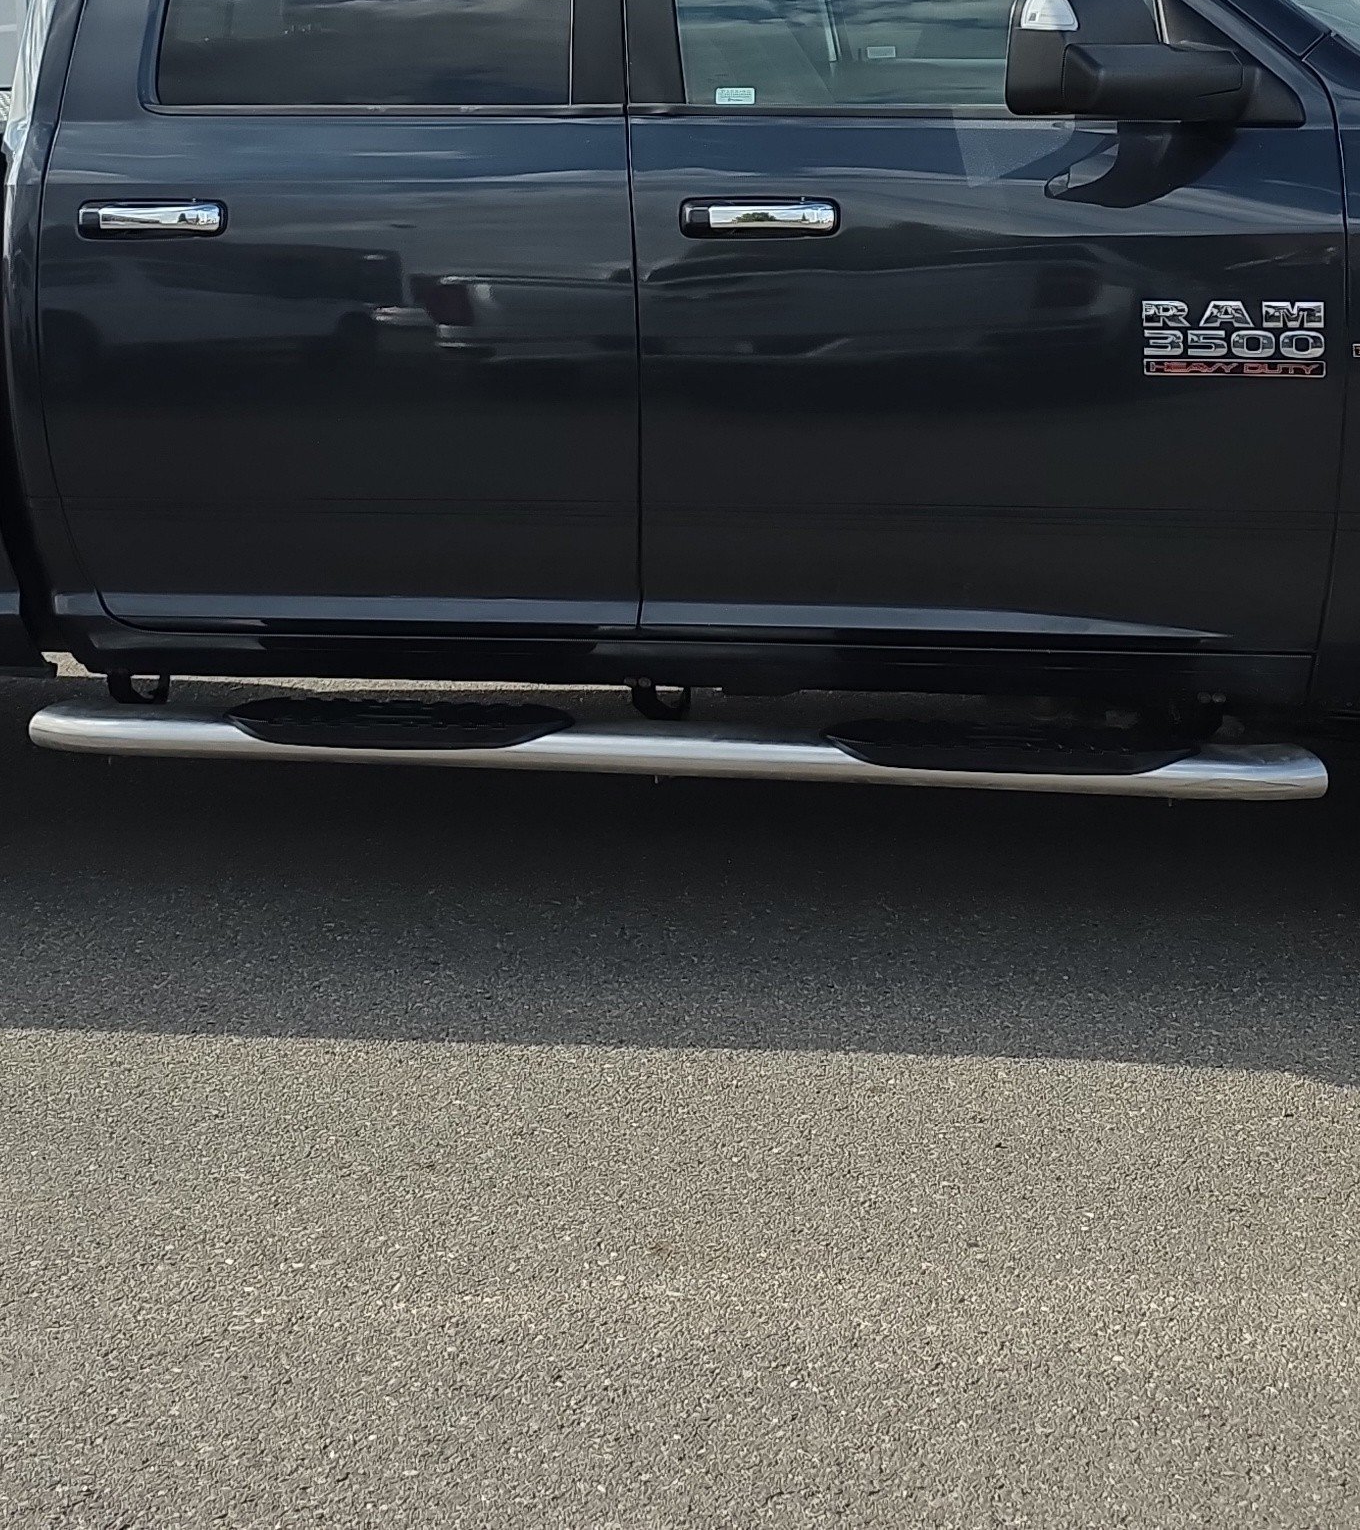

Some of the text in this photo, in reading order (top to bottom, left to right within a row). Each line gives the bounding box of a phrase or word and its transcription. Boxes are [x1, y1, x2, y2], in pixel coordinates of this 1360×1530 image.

[1142, 300, 1325, 328] RAM
[1143, 329, 1326, 358] 3500
[1149, 361, 1320, 375] HEAVY DUTY
